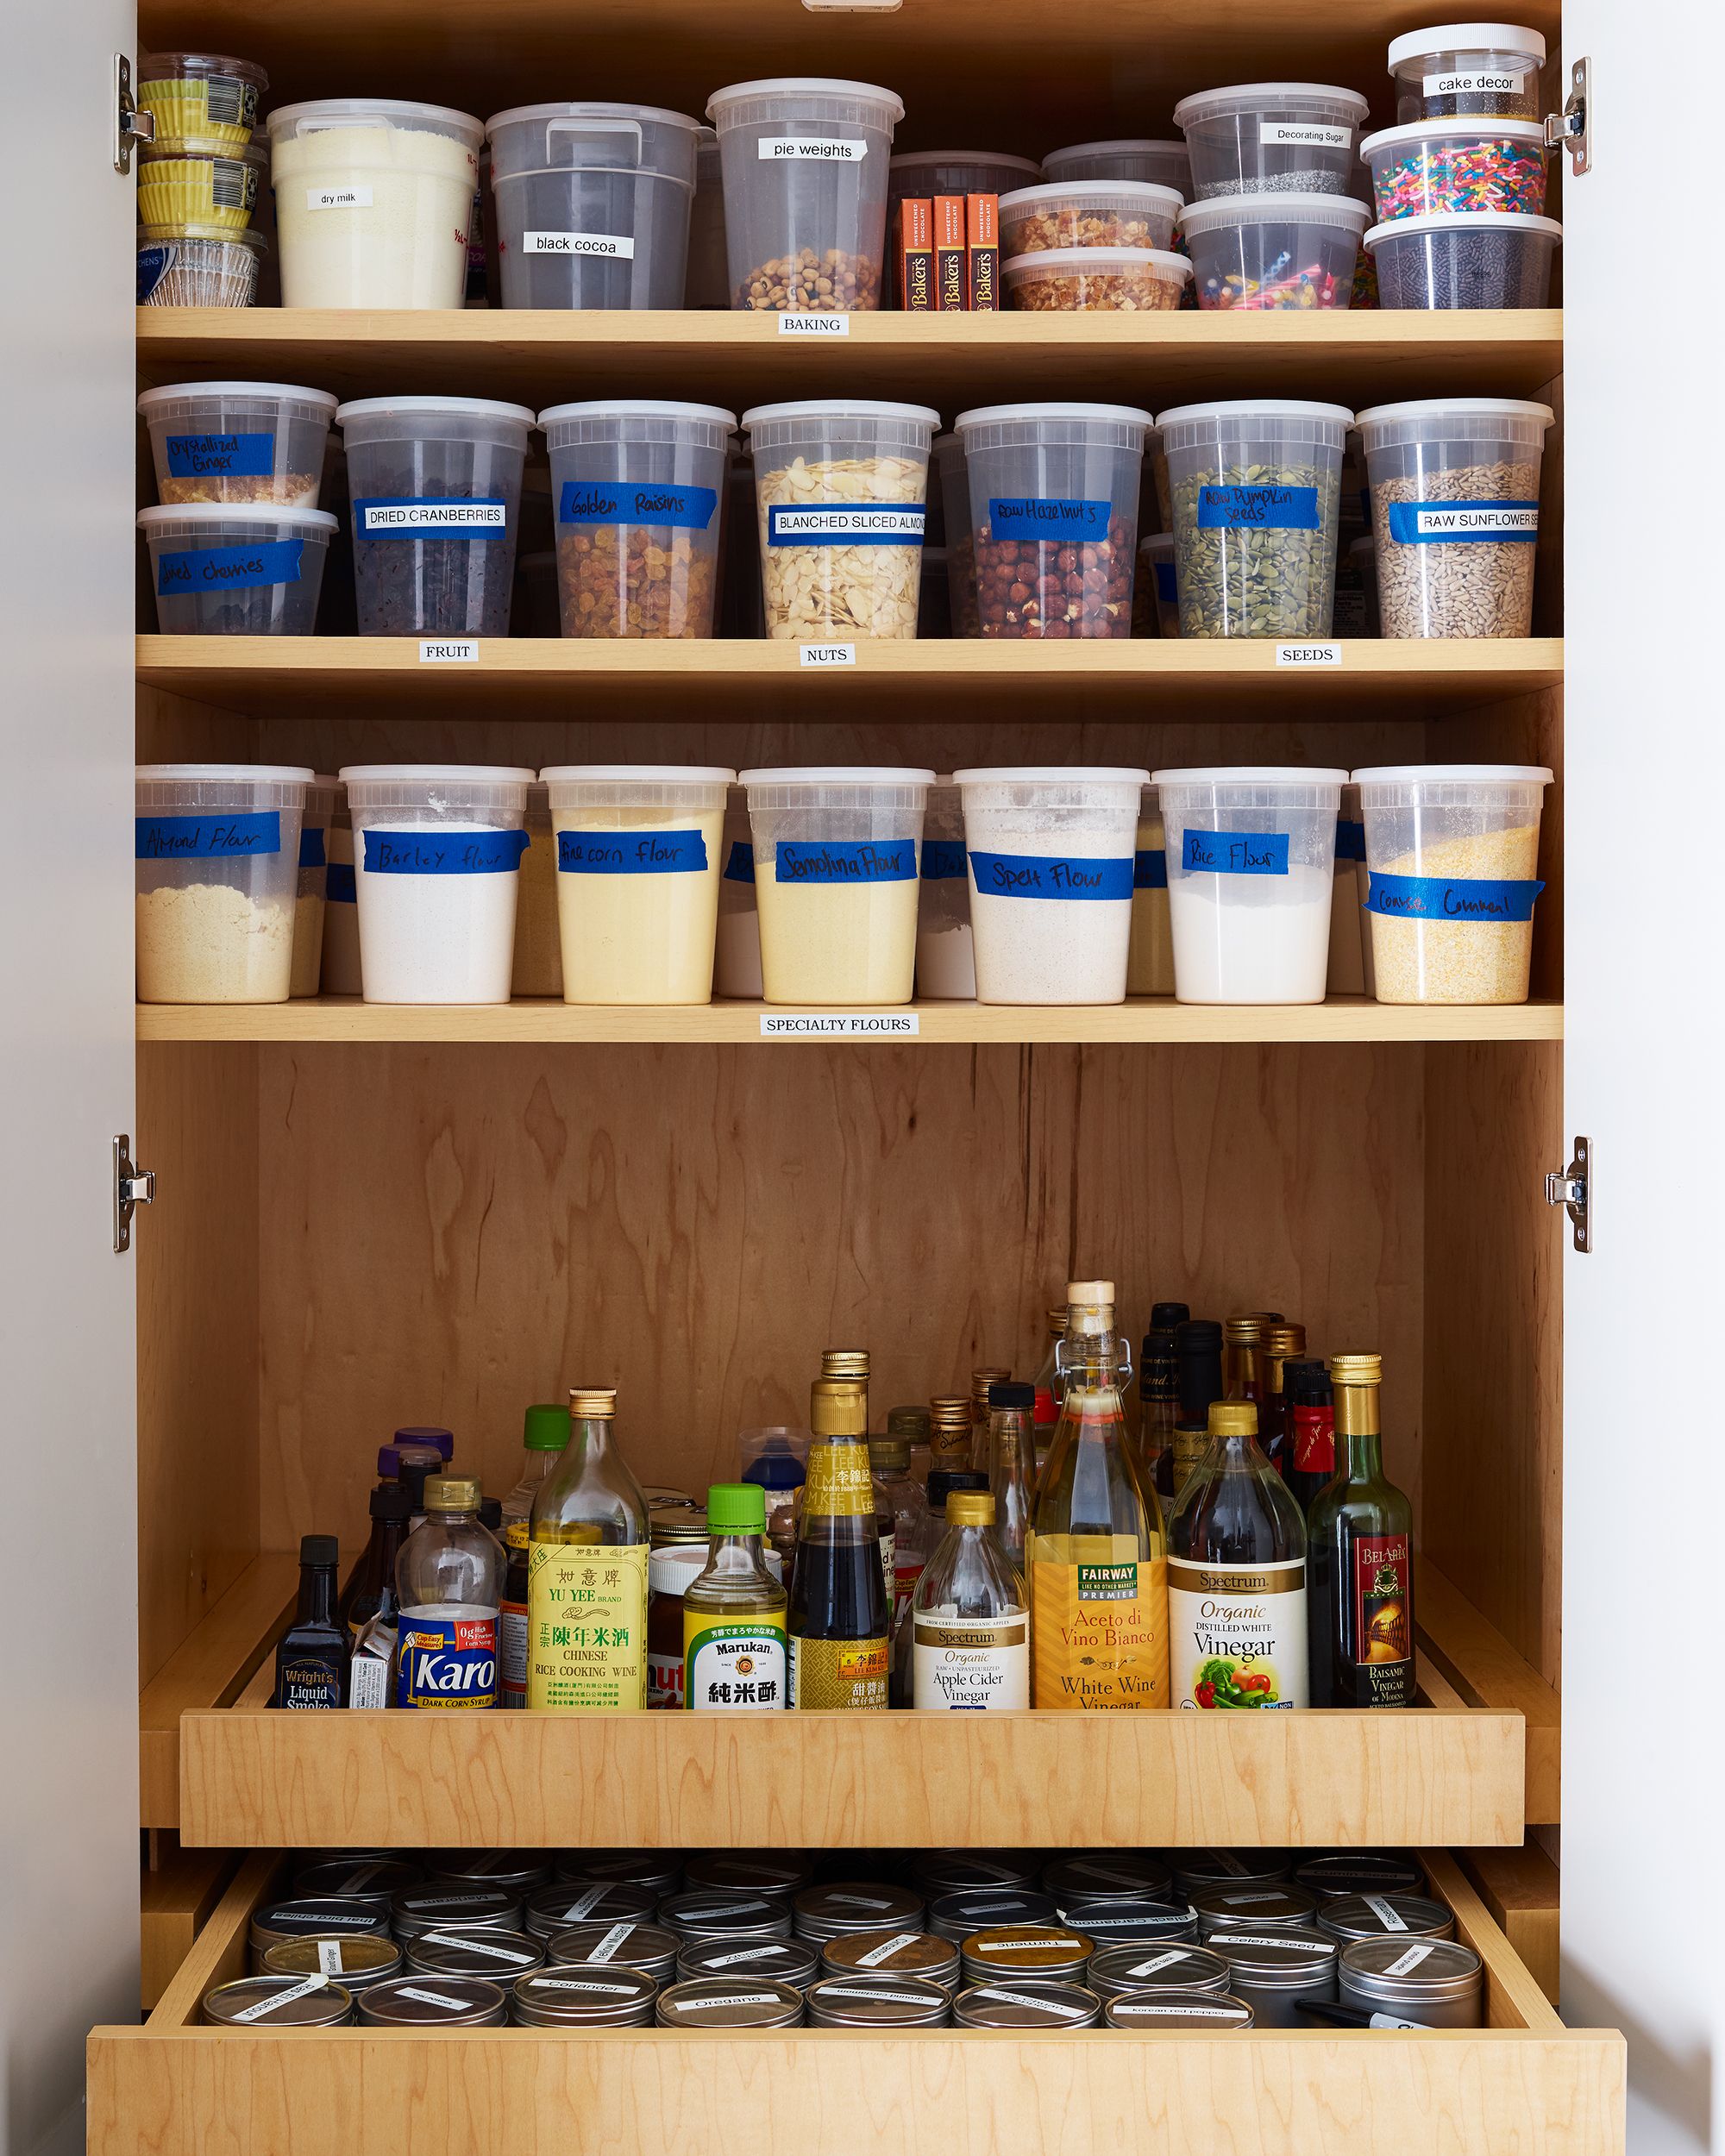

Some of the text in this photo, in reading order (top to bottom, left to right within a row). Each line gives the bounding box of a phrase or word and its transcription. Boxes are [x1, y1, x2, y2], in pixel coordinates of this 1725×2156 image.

[1438, 75, 1514, 91] cake decor
[1277, 128, 1344, 144] Decorating Sugar
[773, 141, 852, 159] pie weights
[321, 193, 355, 204] dry milk
[536, 235, 617, 254] black cocoa
[912, 257, 928, 307] Baker's
[944, 254, 961, 304] Baker's
[976, 253, 993, 303] Baker's
[783, 318, 841, 331] BAKING
[192, 454, 234, 473] Ginger
[572, 489, 687, 515] Golden Raisins
[370, 510, 500, 523] DRIED CRANBERRIES
[780, 514, 897, 530] BLANCHED SLICED
[1424, 514, 1530, 527] RAW SUNFLOWER
[161, 562, 191, 585] dried
[426, 646, 470, 658] FRUIT
[806, 649, 848, 661] NUTS
[1282, 649, 1333, 661] SEEDS
[146, 824, 261, 853] Almond Flour
[379, 843, 445, 870] Barley
[588, 845, 623, 863] corn
[636, 837, 684, 862] flour
[1190, 839, 1276, 868] Rice Flour
[766, 1018, 911, 1031] SPECIALTY FLOURS
[555, 1568, 622, 1588] 如意牌
[1082, 1567, 1135, 1580] FAIRWAY
[1200, 1572, 1266, 1589] Spectrum
[549, 1589, 566, 1601] YU
[569, 1589, 596, 1601] YEE
[1082, 1590, 1134, 1599] PREMIER
[1074, 1608, 1141, 1626] Aceto di
[1201, 1601, 1267, 1622] Organic
[460, 1626, 474, 1639] 0g
[1195, 1622, 1272, 1633] DISTILLED WHITE
[552, 1626, 630, 1647] 陳年米酒
[938, 1630, 995, 1645] Spectrum
[1061, 1627, 1155, 1646] Vino Bianco
[715, 1641, 771, 1656] Marukan
[1193, 1632, 1276, 1663] Vinegar
[563, 1650, 608, 1662] CHINESE
[944, 1650, 991, 1665] Organic
[285, 1670, 334, 1685] Wright's
[416, 1653, 495, 1691] Karo
[535, 1666, 637, 1677] RICE COOKING WINE
[1369, 1666, 1404, 1679] BALSAMIC
[933, 1672, 1004, 1689] Apple Cider
[1060, 1676, 1156, 1695] White Wine
[1371, 1680, 1404, 1692] VINEGAR
[290, 1685, 328, 1703] Liquid
[708, 1681, 777, 1703] 純米酢
[943, 1688, 991, 1705] Vinegar
[422, 1697, 491, 1708] DARK CORN SYRUP
[423, 1894, 490, 1905] Marjoram
[273, 1911, 373, 1925] thai bird chiles
[1373, 1898, 1400, 1925] Rosemary
[594, 1925, 631, 1961] Yellow Mustard
[868, 1937, 908, 1959] Cinnamon
[1227, 1936, 1316, 1950] Celery Seed
[549, 1981, 621, 1992] Coriander
[837, 1988, 885, 1997] cardamom
[242, 1984, 313, 2018] Ras El Hanout
[695, 1994, 762, 2007] Oregano
